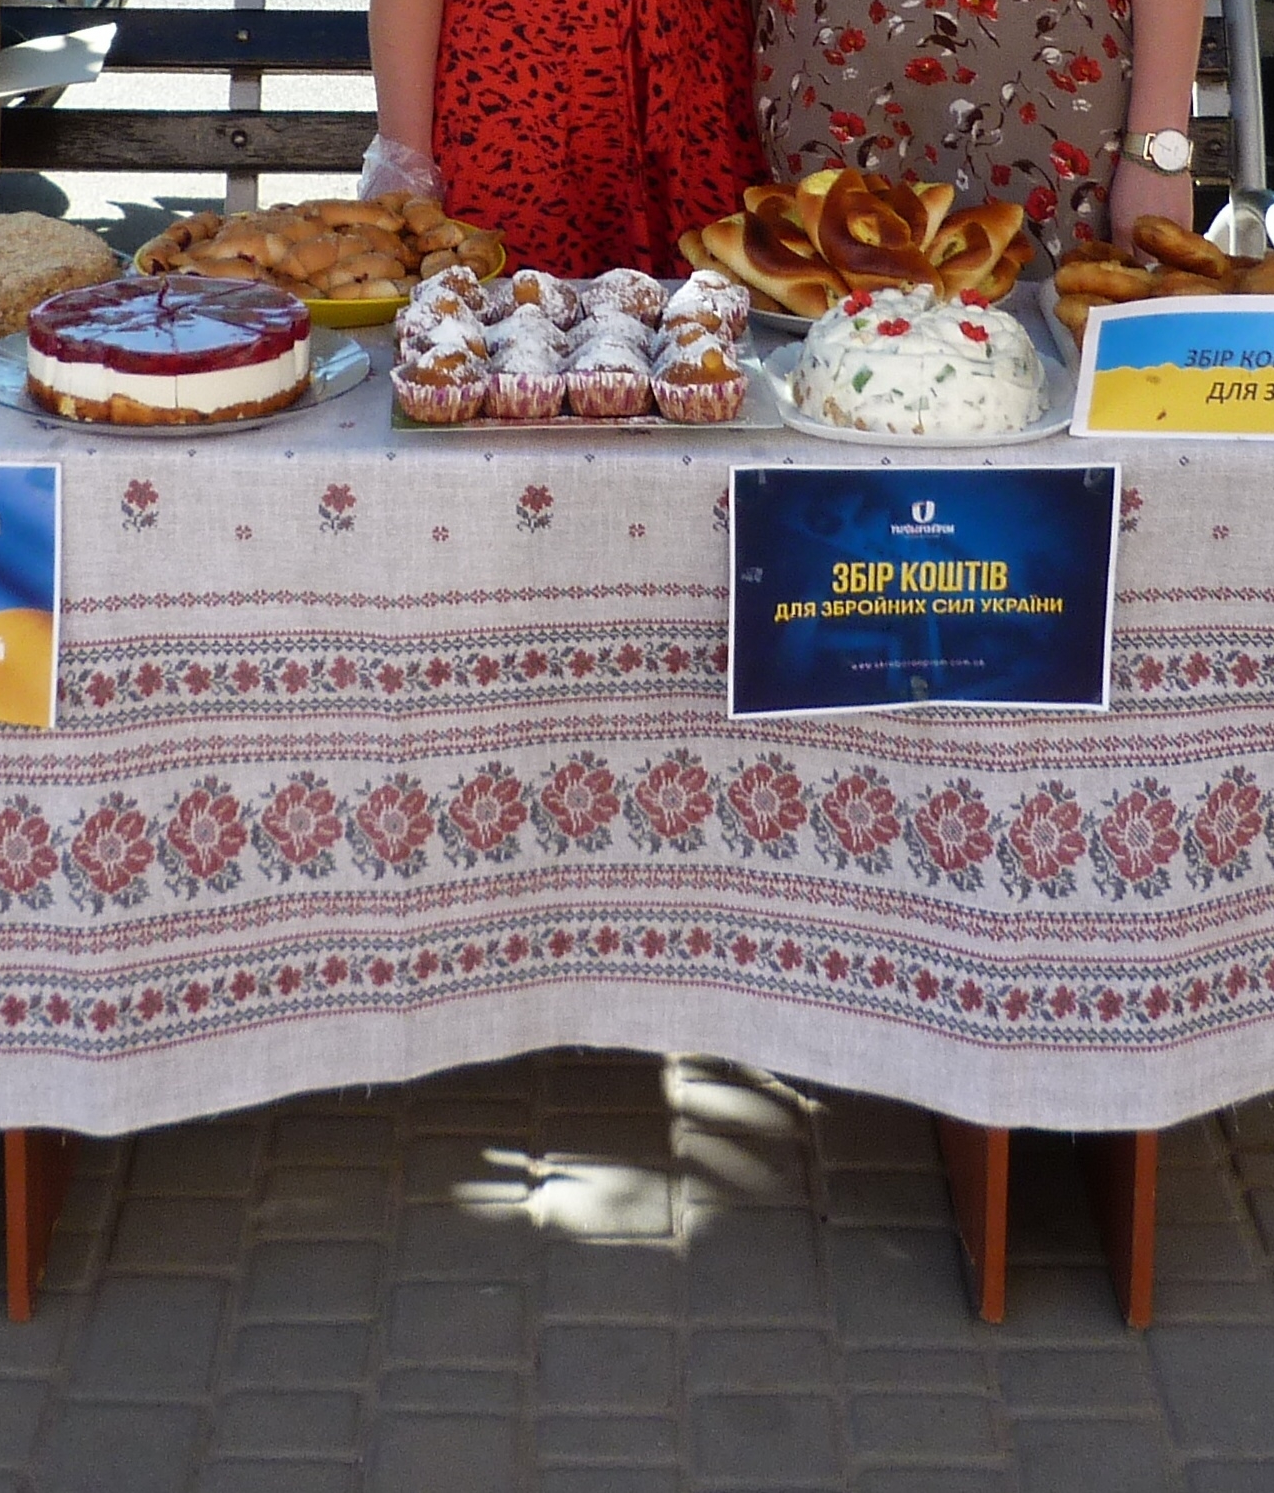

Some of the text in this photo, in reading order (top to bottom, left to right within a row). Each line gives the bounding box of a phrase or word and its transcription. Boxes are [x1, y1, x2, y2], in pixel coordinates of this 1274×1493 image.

[1184, 349, 1235, 368] ЗБІР
[1206, 382, 1258, 405] ДЛЯ
[831, 561, 1009, 594] ЗБІР КОШТІВ
[774, 594, 1064, 623] ДЛЯ ЗБРОЙНИХ СИЛ УКРАЇНИ
